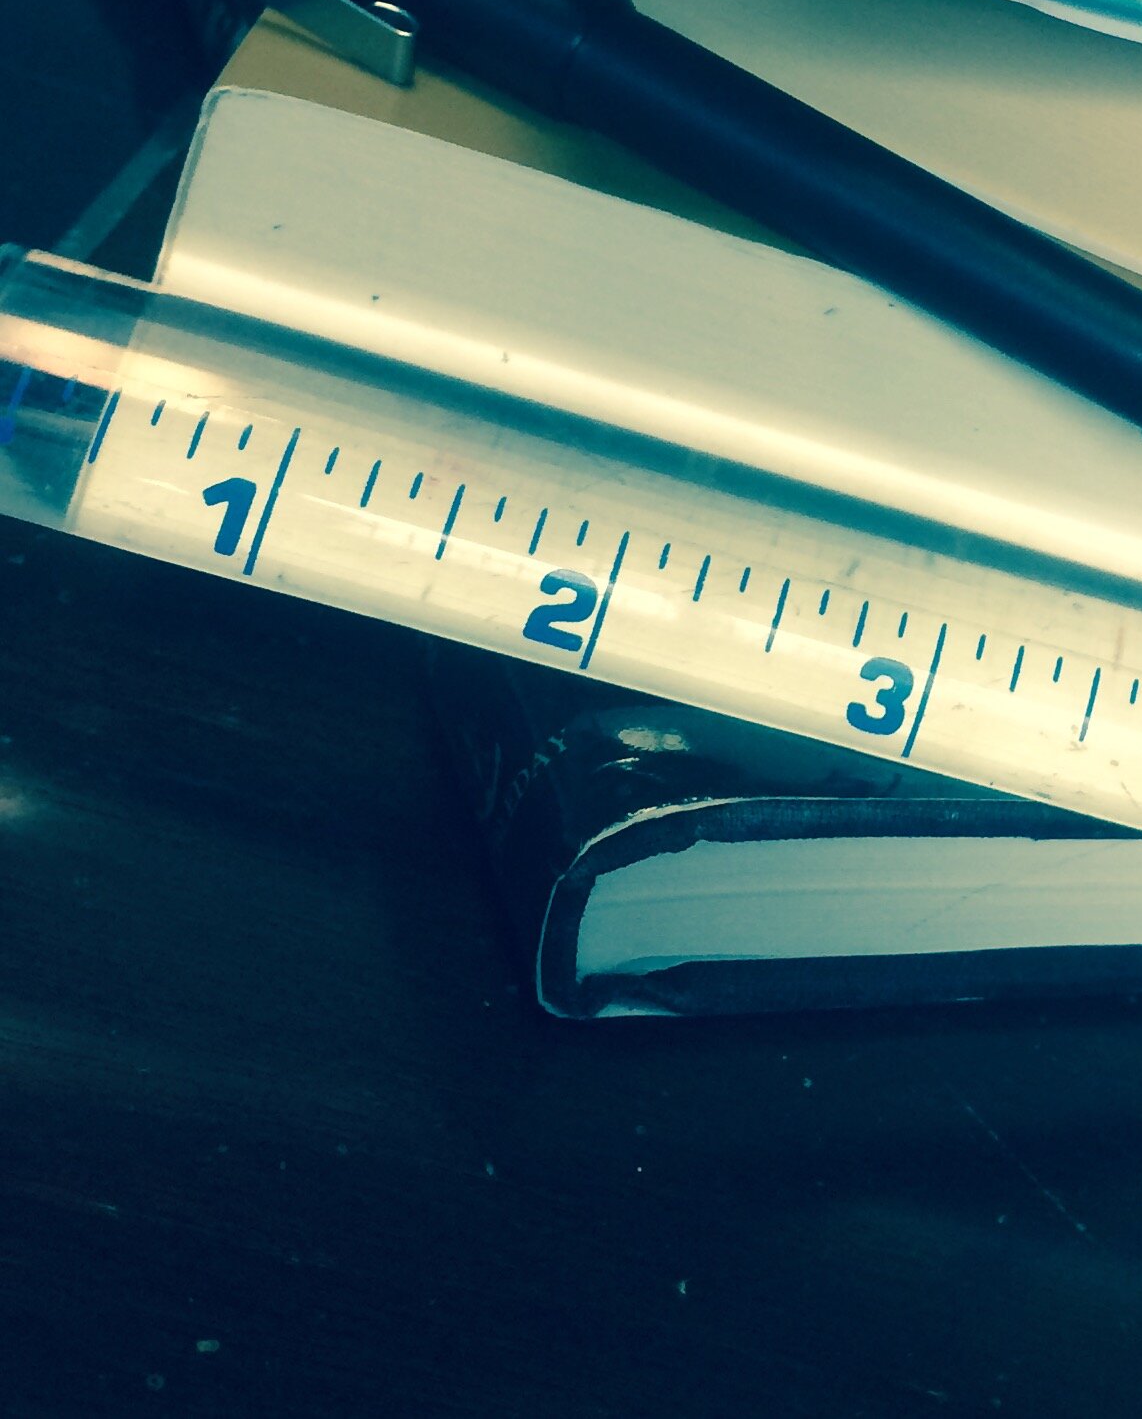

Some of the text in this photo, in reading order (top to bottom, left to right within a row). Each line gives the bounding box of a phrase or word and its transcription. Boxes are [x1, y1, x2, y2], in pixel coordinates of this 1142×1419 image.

[202, 477, 257, 557] 1
[523, 570, 598, 652] 2
[846, 658, 914, 736] 3
